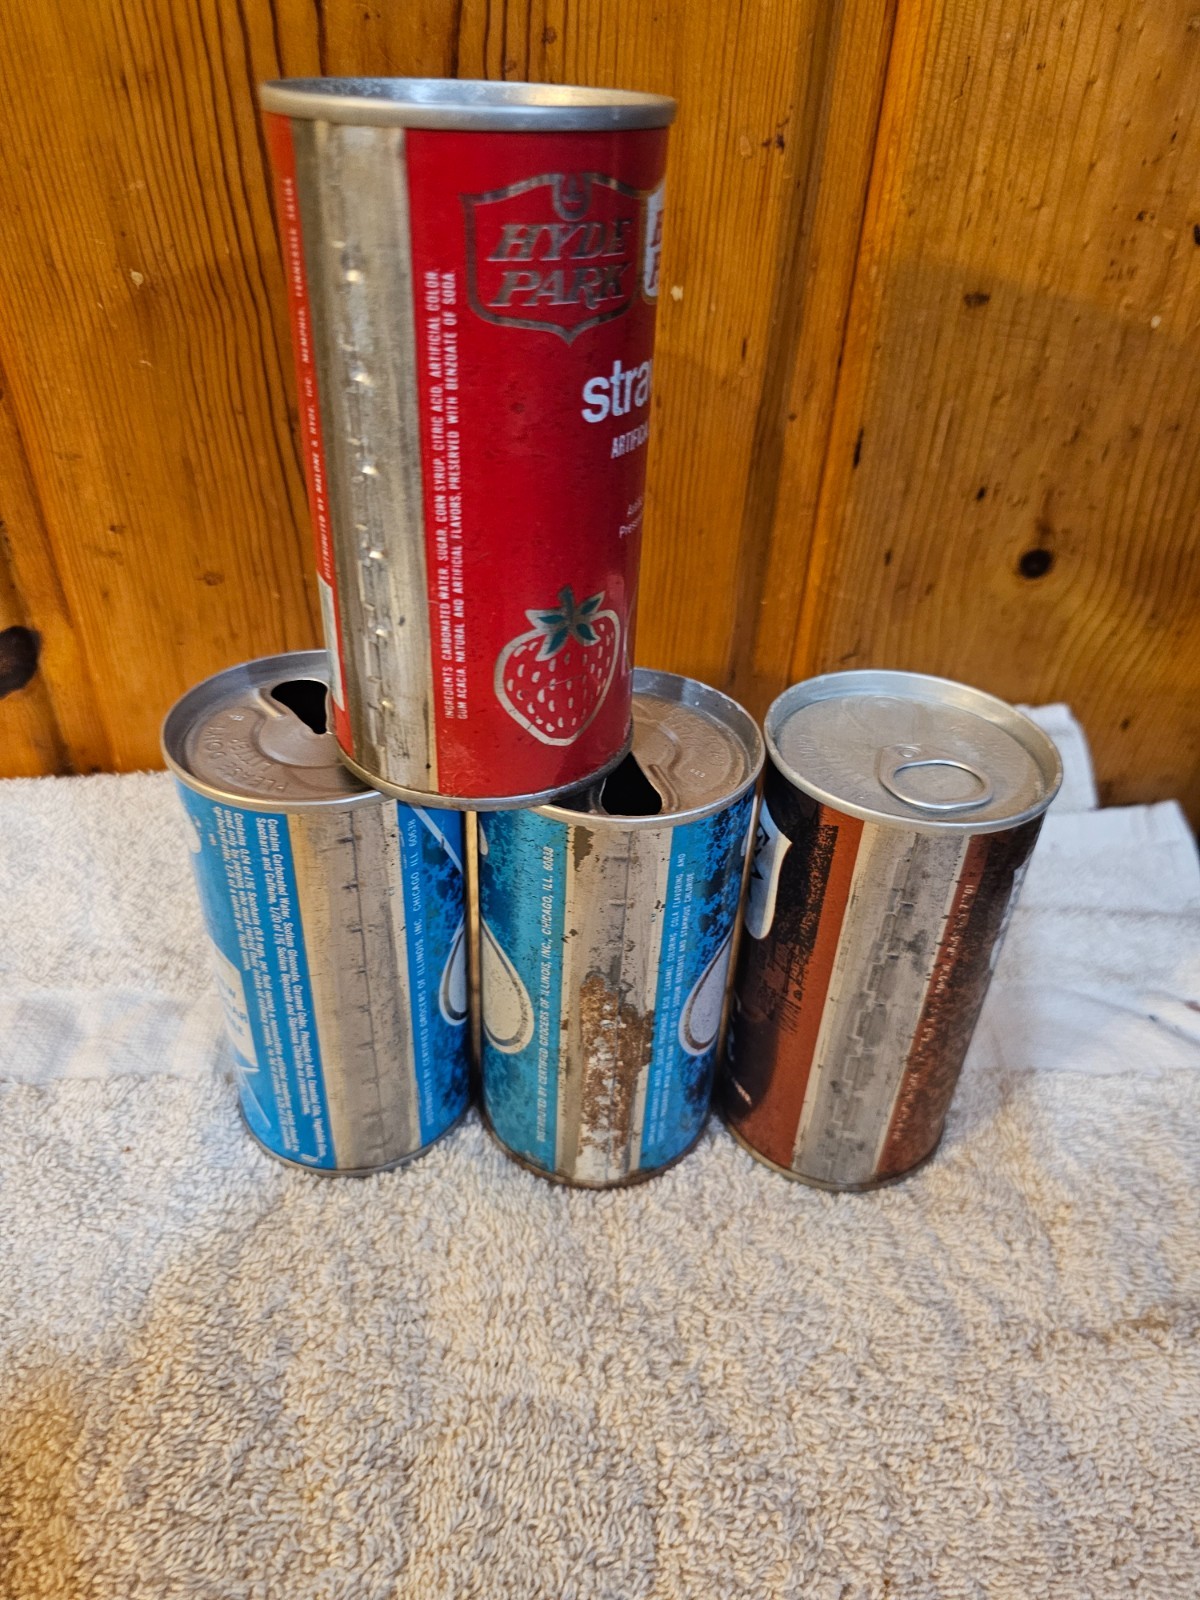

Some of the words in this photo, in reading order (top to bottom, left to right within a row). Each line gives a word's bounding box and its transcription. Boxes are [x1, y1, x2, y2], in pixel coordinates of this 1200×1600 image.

[486, 218, 632, 262] HYDE
[488, 262, 631, 309] PARK
[442, 311, 456, 325] OF
[427, 316, 442, 377] ARTIFICIAL
[581, 360, 653, 423] stra
[445, 396, 459, 423] WITH
[431, 416, 444, 450] CITRIC
[446, 431, 460, 489] PRESERVED
[316, 496, 325, 511] BY
[434, 494, 446, 522] CORN
[450, 545, 463, 593] ARTIFICIAL
[452, 598, 464, 617] AND
[438, 602, 452, 660] CARBONATED
[453, 623, 465, 662] NATURAL
[456, 701, 467, 719] GUM
[223, 809, 234, 829] used
[233, 811, 248, 846] Contains
[407, 818, 417, 846] 60638
[226, 829, 238, 847] only
[255, 816, 270, 855] Saccharin
[267, 818, 282, 851] Contains
[230, 848, 240, 859] by
[239, 847, 251, 865] 0.04
[261, 855, 273, 871] and
[226, 878, 236, 888] of
[232, 858, 245, 888] persons
[242, 865, 253, 876] of
[243, 875, 255, 891] 1%
[272, 853, 288, 896] Carbonated
[237, 889, 248, 905] who
[264, 872, 278, 904] Caffeine,
[683, 871, 695, 903] CHLORIDE
[229, 893, 242, 919] calorie
[240, 906, 251, 925] must
[246, 890, 261, 926] Saccharin
[269, 905, 280, 923] 1/20
[279, 896, 292, 919] Water,
[541, 894, 553, 934] CHICAGO,
[234, 918, 244, 932] per
[272, 923, 282, 931] of
[663, 964, 673, 991] CARAMEL
[670, 910, 679, 927] COLA
[676, 852, 686, 867] AND
[679, 904, 691, 937] STANNOUS
[236, 932, 248, 950] fluid
[243, 925, 256, 951] restrict
[273, 932, 284, 944] 1%
[283, 921, 296, 947] Sodium
[678, 939, 686, 952] AND
[248, 950, 259, 968] their
[258, 959, 269, 973] per
[275, 945, 288, 971] Sodium
[287, 948, 301, 982] Gluconate,
[674, 954, 684, 983] BENZOATE
[251, 968, 263, 989] intake
[261, 973, 272, 990] fluid
[280, 972, 293, 1002] Benzoate
[416, 978, 426, 988] OF
[255, 989, 265, 998] of
[292, 984, 306, 1011] Caramel
[539, 997, 550, 1008] OF
[284, 1002, 295, 1015] and
[286, 1016, 299, 1044] Stannous
[538, 1010, 549, 1046] GROCERS
[291, 1044, 303, 1069] Chloride
[299, 1030, 314, 1063] Phosphoric
[537, 1047, 548, 1084] CERTIFIED
[537, 1085, 547, 1096] BY
